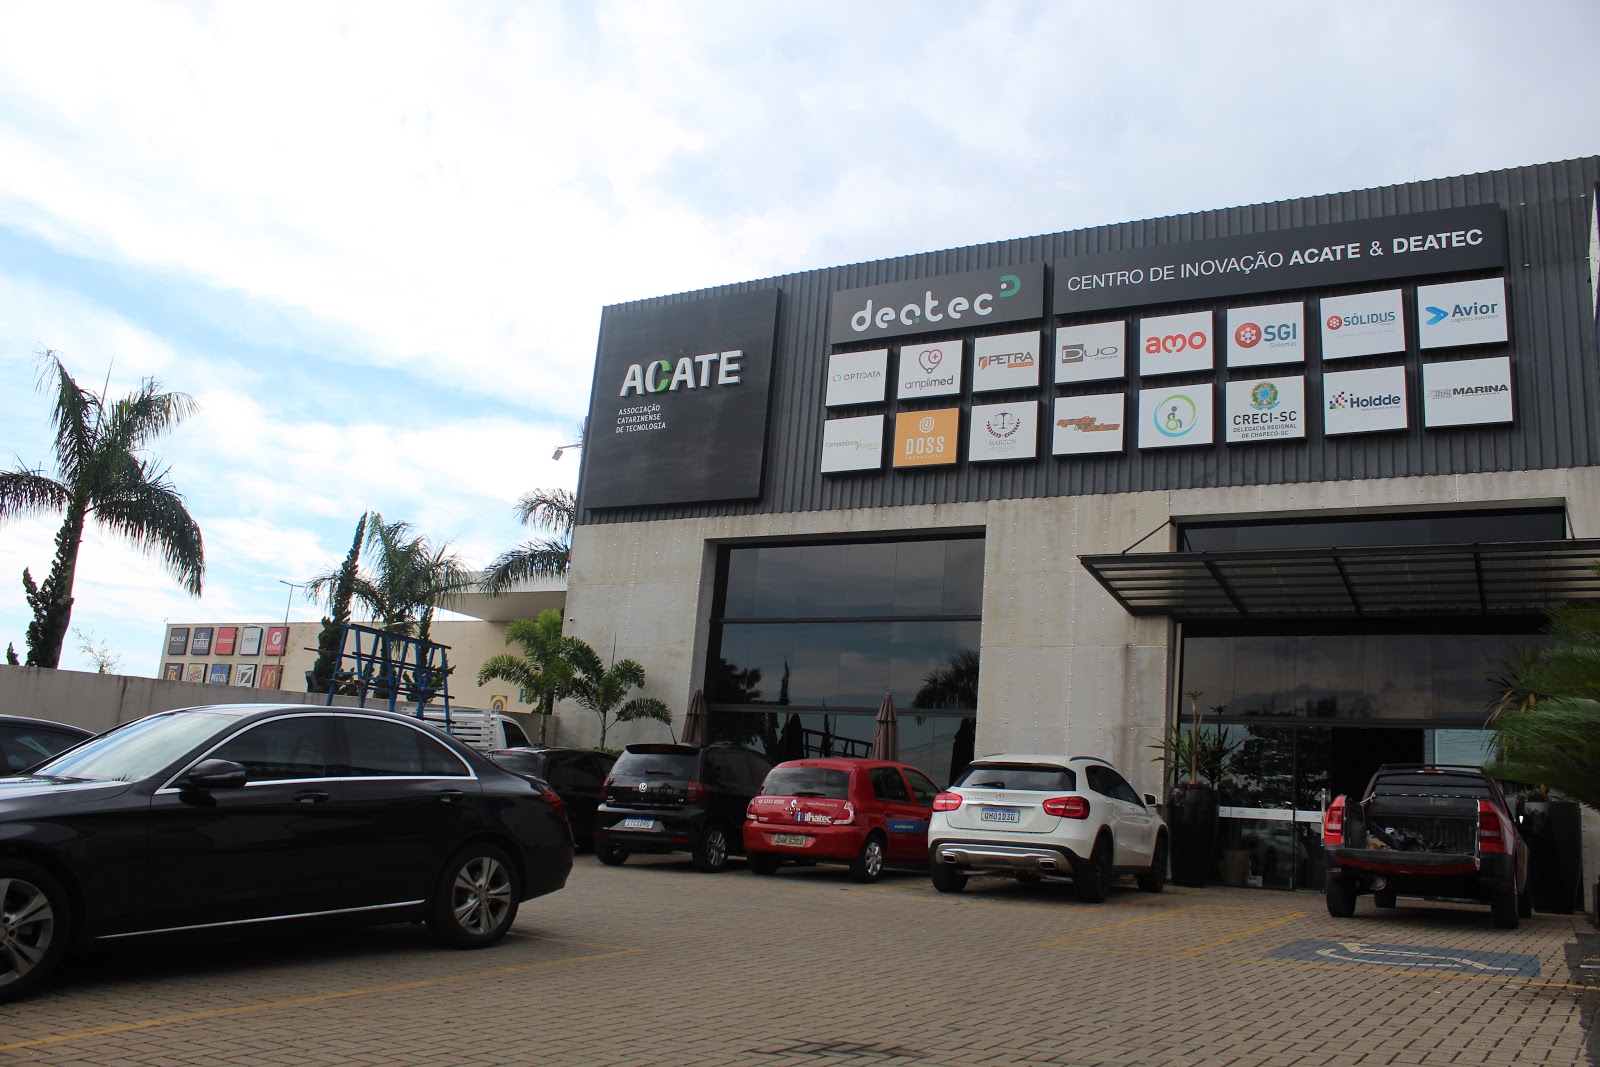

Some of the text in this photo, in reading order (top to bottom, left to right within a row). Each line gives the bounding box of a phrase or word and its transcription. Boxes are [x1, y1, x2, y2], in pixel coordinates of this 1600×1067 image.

[1067, 229, 1483, 291] CENTRO DE INOVAÇÃO ACATE & DEATEC
[851, 290, 993, 332] deatec
[1451, 302, 1498, 317] Avior
[1343, 312, 1396, 326] SÓLIDUS
[1263, 322, 1297, 343] SGI
[1145, 331, 1207, 354] amo
[1269, 341, 1297, 349] Sistemas
[988, 351, 1034, 366] PETRA
[619, 349, 744, 398] ACATE
[904, 375, 954, 390] amplimed
[1452, 384, 1509, 396] MARINA
[618, 403, 661, 416] ASSOCIAÇÃO
[617, 413, 661, 425] CATARINENSE
[1233, 410, 1297, 426] CRECI-SC
[615, 421, 667, 434] DE TECNOLOGIA
[1233, 423, 1298, 433] DELEGACIA REGIONAL
[905, 435, 945, 455] DOSS
[988, 438, 1017, 447] MARCON
[804, 812, 832, 823] ilhatec
